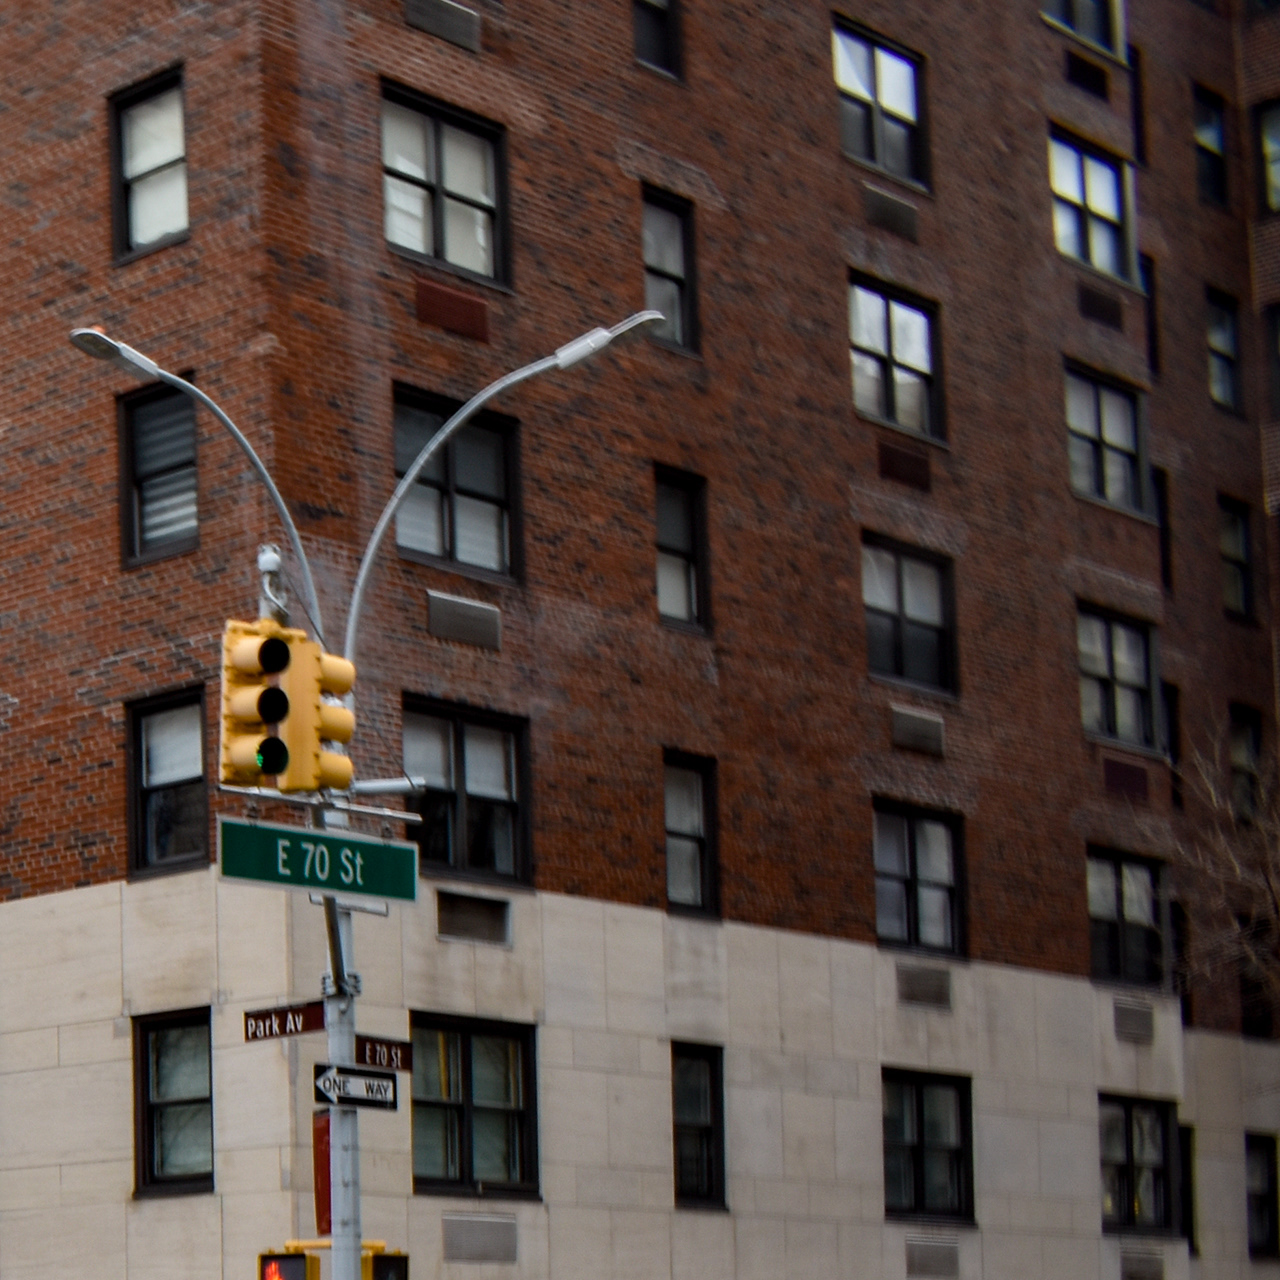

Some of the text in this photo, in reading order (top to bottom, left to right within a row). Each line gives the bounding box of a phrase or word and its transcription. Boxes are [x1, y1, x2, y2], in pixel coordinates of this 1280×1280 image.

[277, 838, 364, 886] E 70 St
[247, 1012, 304, 1041] Park Av
[365, 1041, 402, 1068] E 70 St
[322, 1077, 390, 1100] ONE WAY
